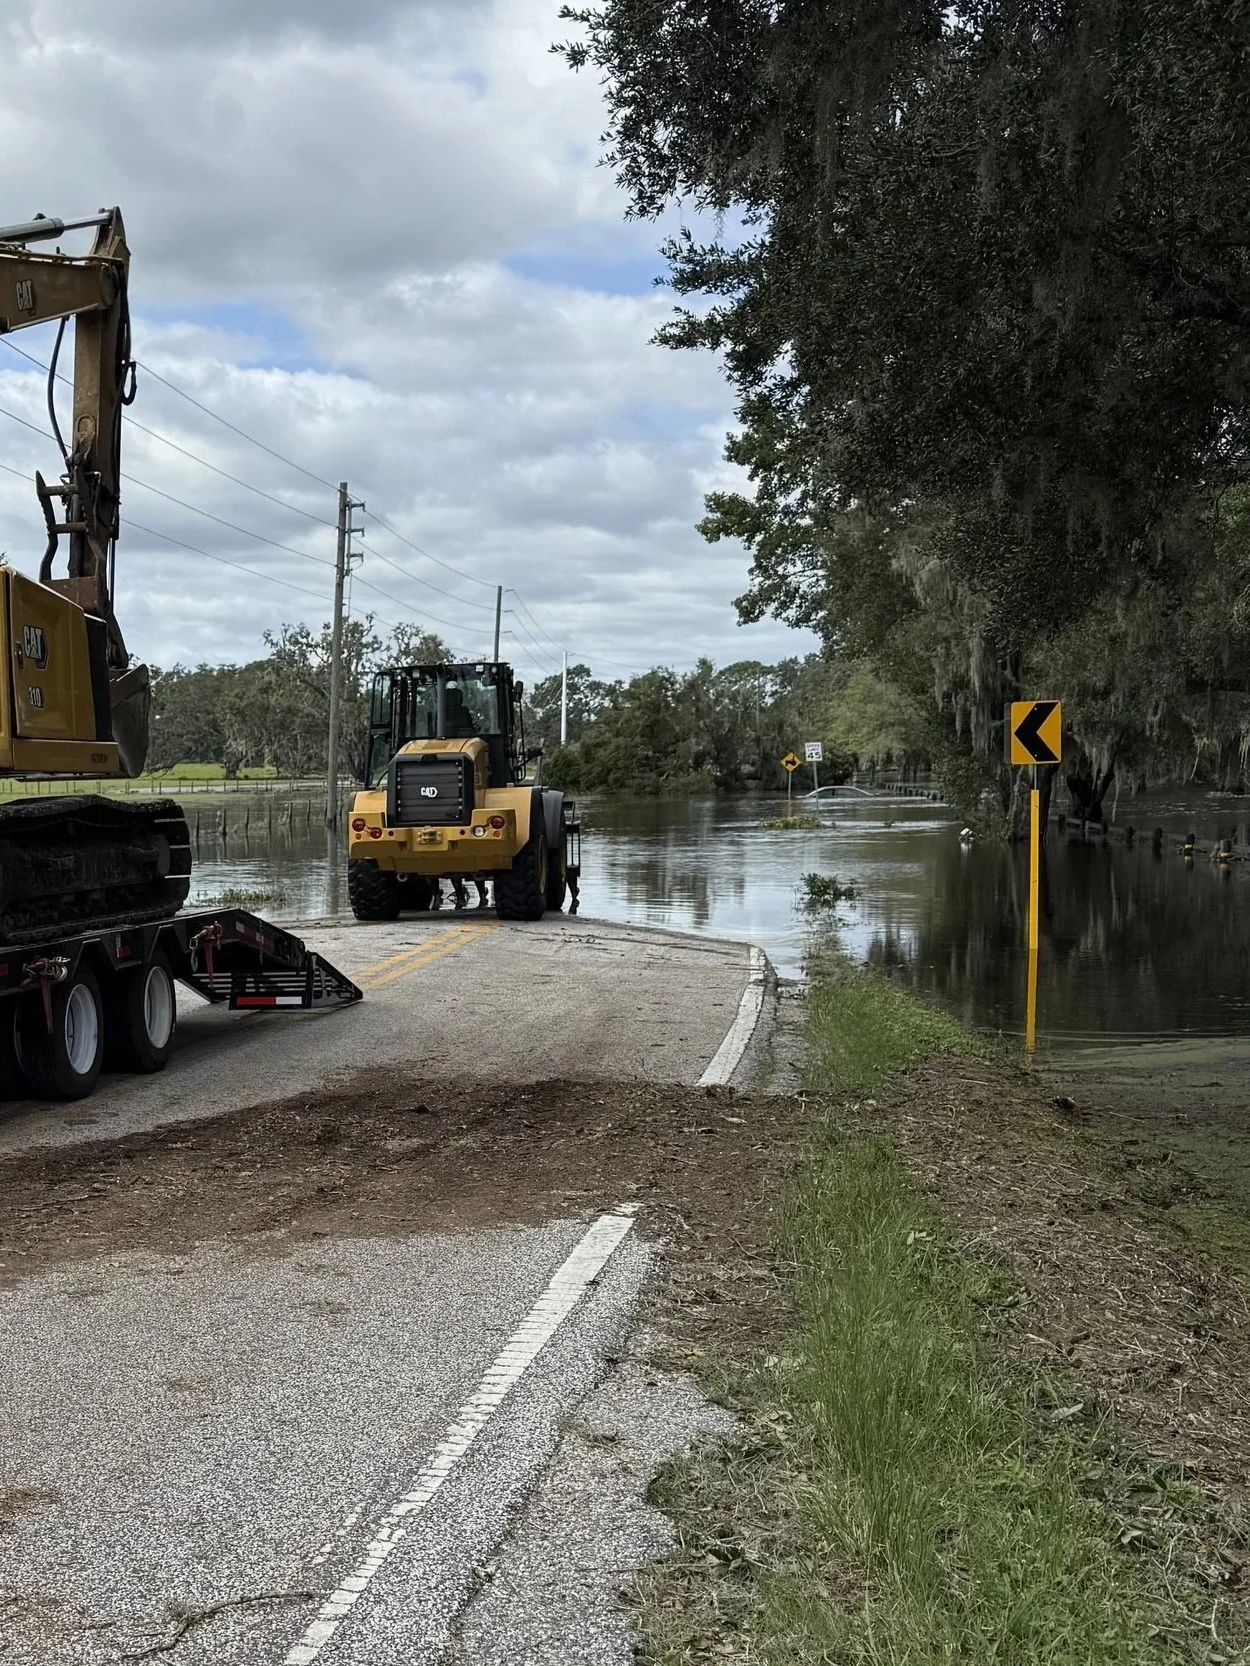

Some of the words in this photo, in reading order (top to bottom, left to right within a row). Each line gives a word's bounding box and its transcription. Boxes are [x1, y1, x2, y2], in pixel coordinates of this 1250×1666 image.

[16, 280, 33, 310] CAT
[24, 625, 43, 660] CAT
[28, 686, 42, 708] 310
